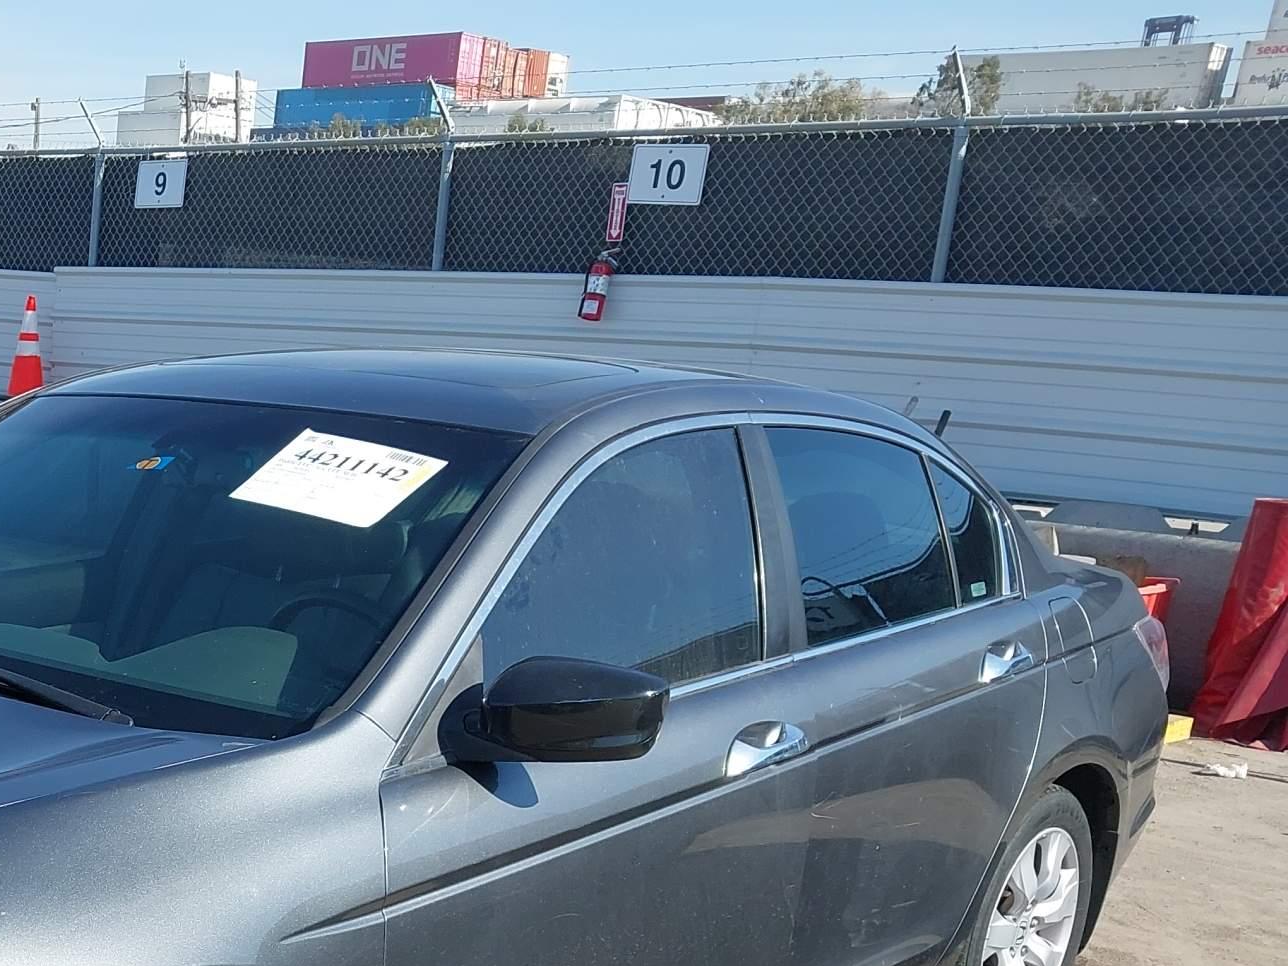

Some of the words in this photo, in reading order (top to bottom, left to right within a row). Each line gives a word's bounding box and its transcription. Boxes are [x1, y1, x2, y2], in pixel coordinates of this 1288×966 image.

[352, 43, 407, 71] ONE
[155, 172, 166, 195] 9
[650, 159, 685, 190] 10
[294, 448, 409, 481] 44211142
